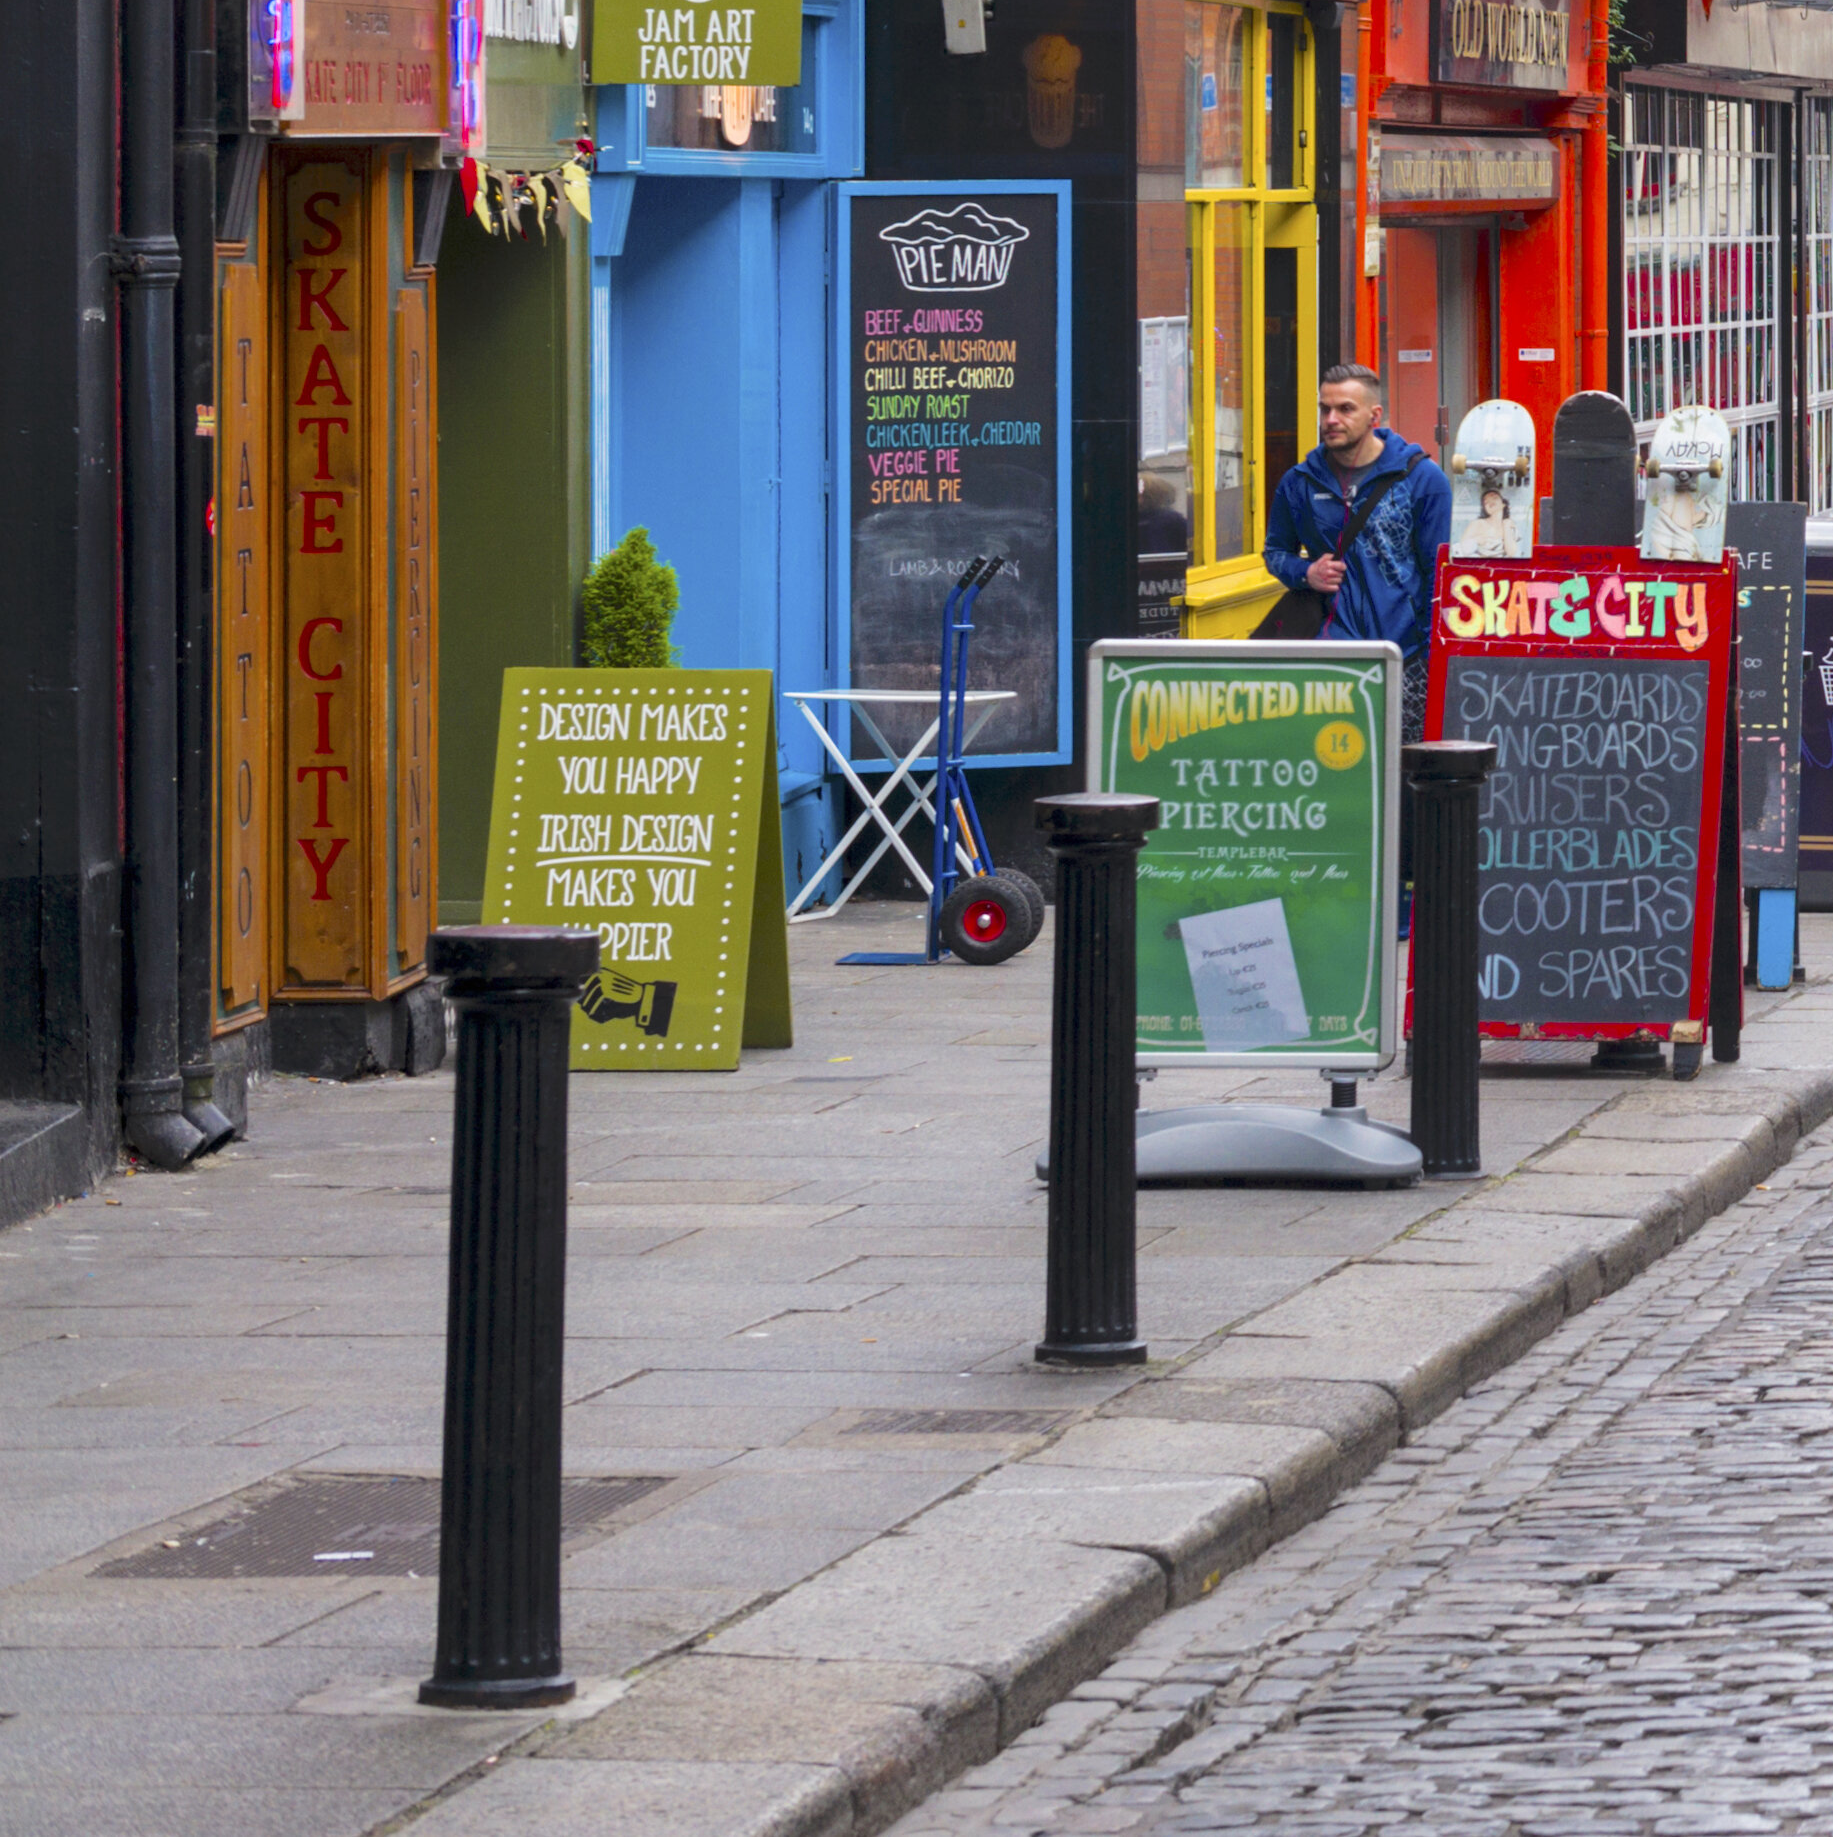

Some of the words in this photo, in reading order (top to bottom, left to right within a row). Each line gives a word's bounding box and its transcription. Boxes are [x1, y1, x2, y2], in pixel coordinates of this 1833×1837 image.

[638, 9, 695, 43] JAM
[705, 9, 755, 43] ART
[1487, 2, 1537, 63] WORLD
[344, 61, 370, 104] CITY
[396, 62, 432, 104] FLOOR
[640, 46, 752, 80] FACTORY
[865, 309, 903, 335] BEEF
[913, 309, 984, 334] GUINNESS
[865, 338, 928, 363] CHICKEN
[940, 340, 1017, 363] MUSHROOM
[293, 190, 353, 556] SKATE
[865, 366, 906, 392] CHILLI
[913, 366, 947, 390] BEEF
[957, 366, 1014, 389] CHORIZO
[866, 394, 921, 420] SUNDAY
[926, 394, 971, 419] ROAST
[981, 421, 1041, 446] CHEDDAR
[868, 450, 928, 477] VEGGIE
[936, 449, 961, 474] PIE
[871, 479, 933, 504] SPECIAL
[938, 478, 963, 503] PIE
[408, 349, 424, 901] PIERCING
[1441, 574, 1592, 638] SKATE
[1596, 574, 1709, 652] CITY
[234, 337, 254, 938] TATTOO
[1459, 670, 1704, 723] SKATEBOARDS
[537, 703, 631, 741] DESIGN
[639, 703, 728, 741] MAKES
[1131, 680, 1298, 762] CONNECTED
[1304, 680, 1355, 715] INK
[296, 618, 351, 901] CITY
[558, 756, 607, 795] YOU
[615, 756, 702, 795] HAPPY
[1170, 758, 1318, 797] TATTOO
[537, 815, 611, 853] IRISH
[620, 815, 714, 853] DESIGN
[1159, 795, 1327, 837] PIERCING
[1198, 845, 1288, 861] TEMPLEBAR
[546, 868, 635, 907] MAKES
[646, 868, 696, 907] YOU
[1538, 945, 1689, 1001] SPARES
